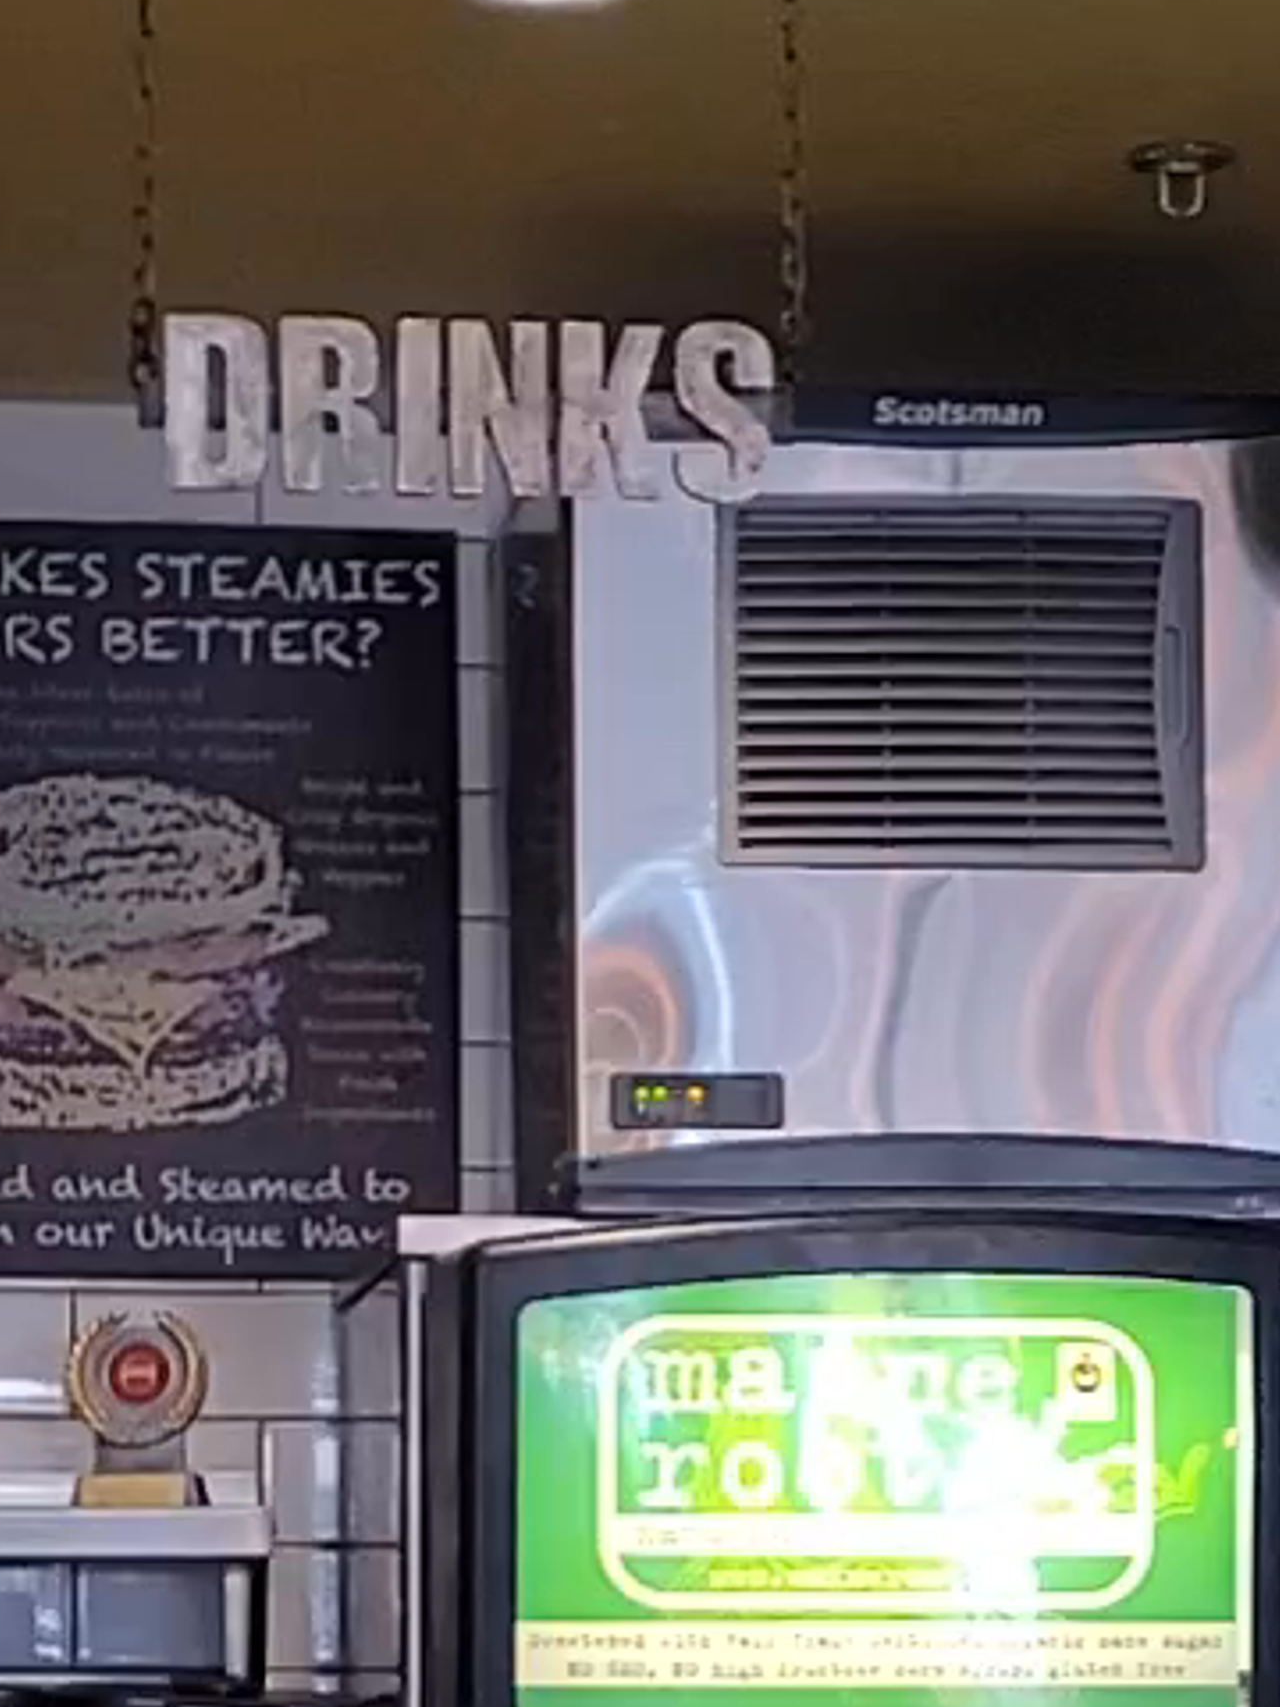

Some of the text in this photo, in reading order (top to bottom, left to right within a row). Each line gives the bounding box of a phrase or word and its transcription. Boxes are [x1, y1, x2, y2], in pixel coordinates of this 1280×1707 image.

[162, 310, 777, 505] DRINKS
[872, 395, 1045, 430] Scotsman
[136, 554, 442, 608] STEAMIES
[101, 616, 384, 669] BETTER?
[53, 1166, 140, 1203] and
[159, 1163, 352, 1204] Steamed
[363, 1167, 411, 1203] to
[35, 1218, 115, 1247] our
[134, 1213, 290, 1264] Unique
